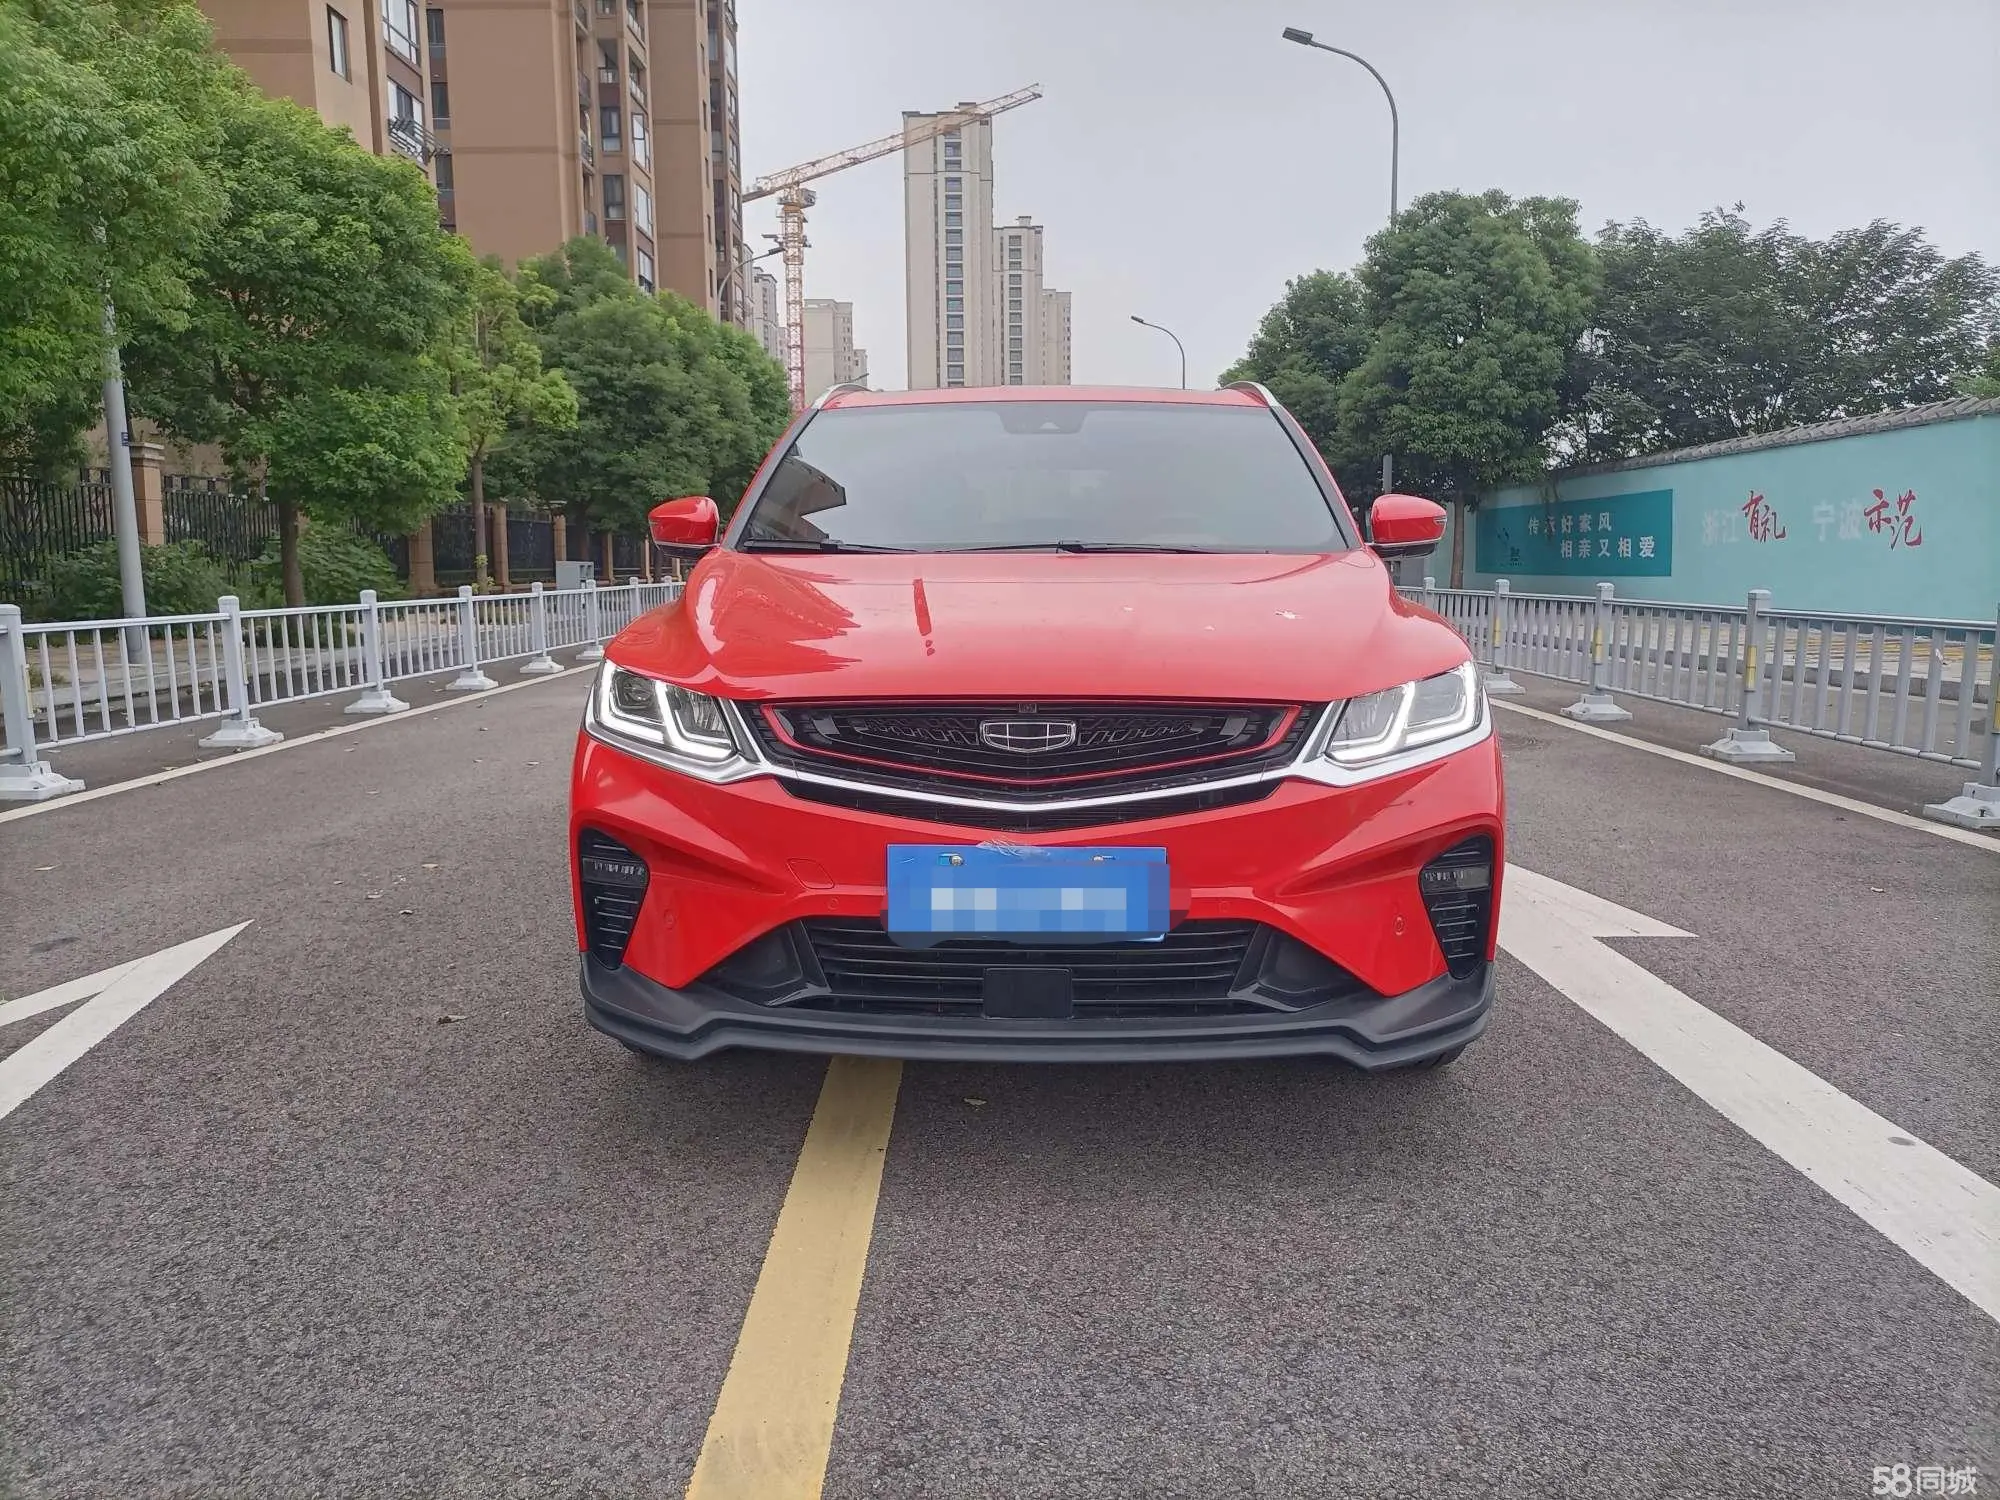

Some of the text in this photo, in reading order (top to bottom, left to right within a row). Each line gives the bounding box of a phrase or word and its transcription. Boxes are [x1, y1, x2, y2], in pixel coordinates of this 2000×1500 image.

[1812, 488, 1922, 551] 宁波示范
[1560, 535, 1656, 560] 相亲又相爱
